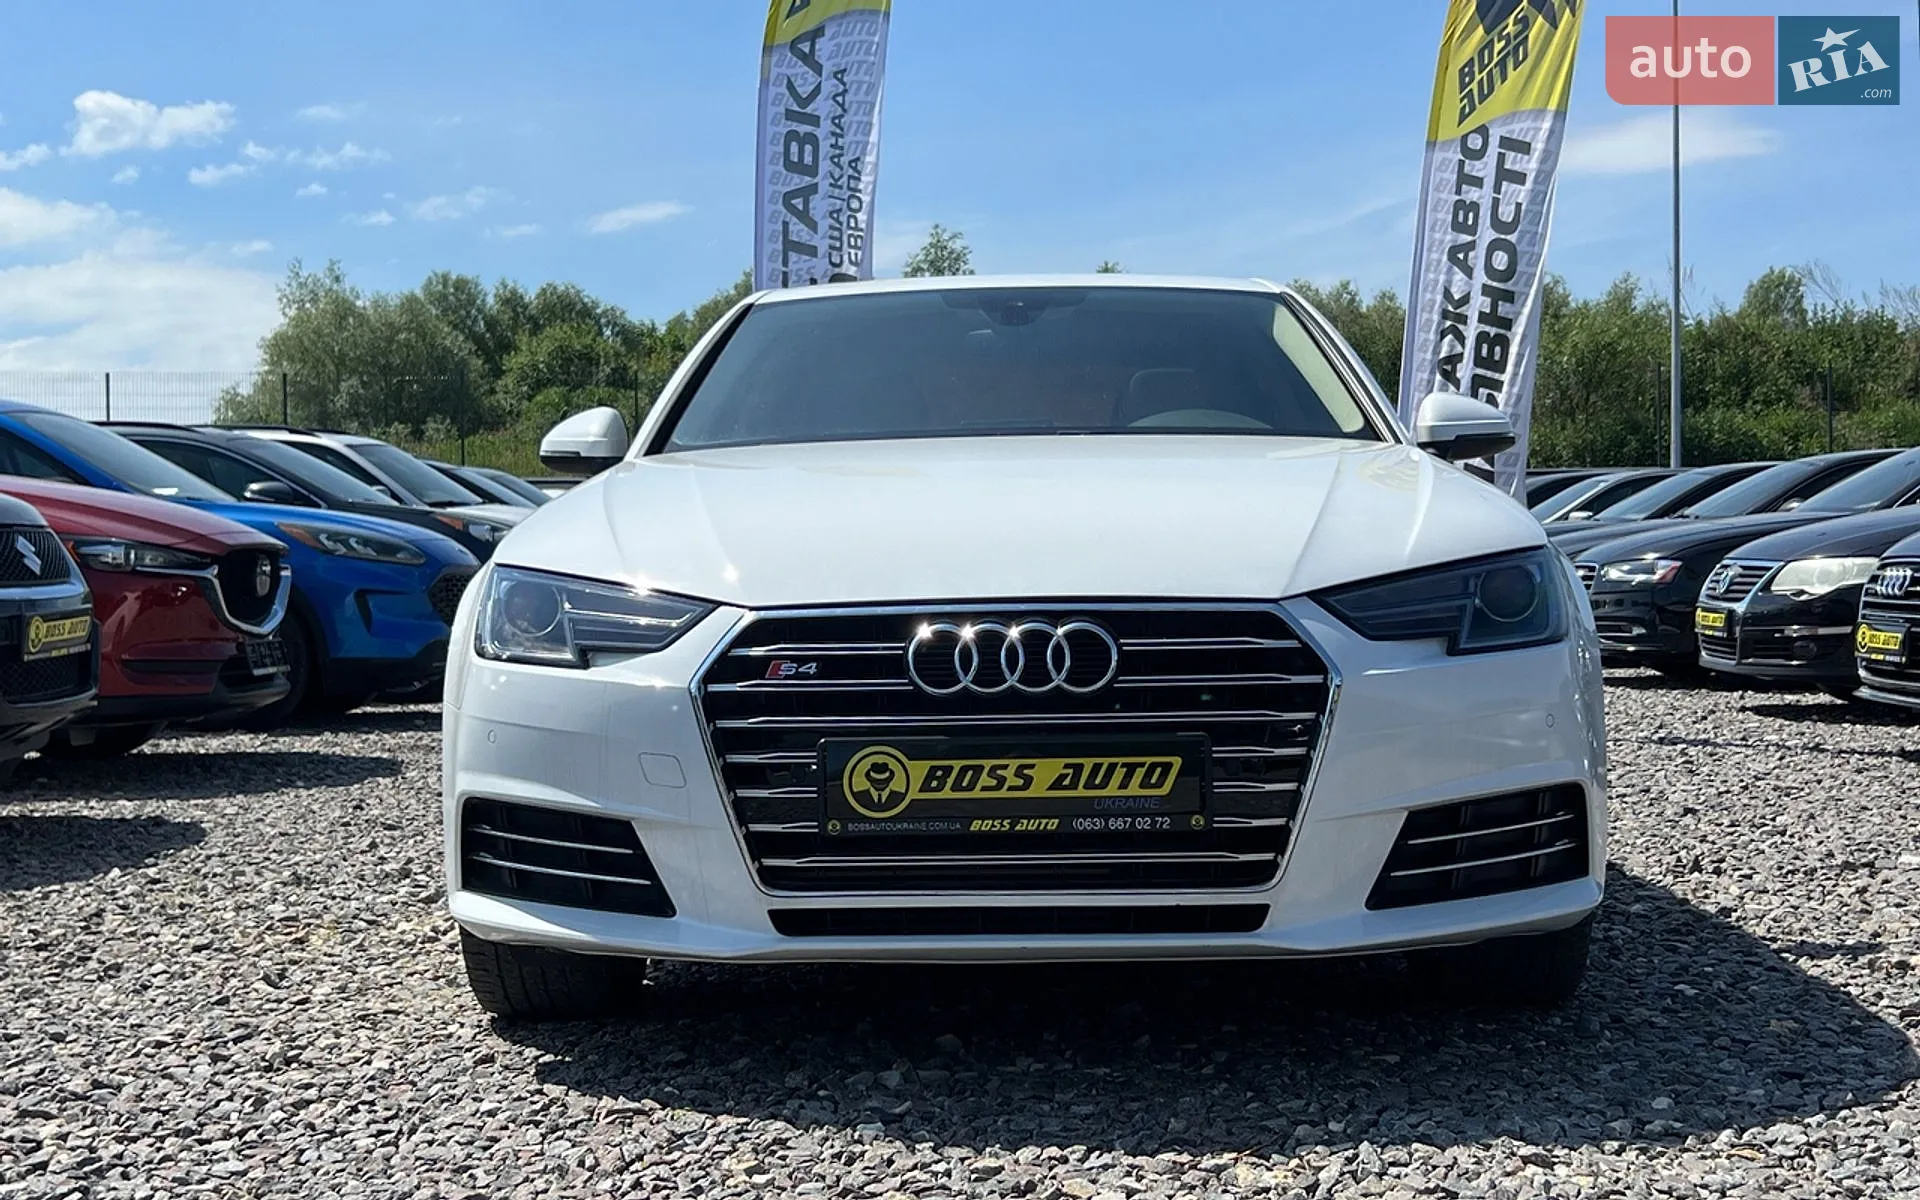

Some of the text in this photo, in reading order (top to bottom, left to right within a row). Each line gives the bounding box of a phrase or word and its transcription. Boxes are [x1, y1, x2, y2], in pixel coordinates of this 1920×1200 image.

[1458, 6, 1530, 94] BOSS
[1458, 34, 1529, 128] AUTO
[1447, 123, 1490, 280] АВТО
[827, 207, 844, 268] США
[777, 662, 817, 675] S4
[918, 761, 1174, 793] BOSS AUTO
[969, 819, 1011, 831] BOSS
[1014, 818, 1060, 831] AUTO
[1072, 817, 1105, 830] (063)
[1108, 817, 1133, 830] 667
[1135, 817, 1151, 830] 02
[1155, 817, 1171, 830] 72
[1093, 797, 1162, 810] UKRAINE
